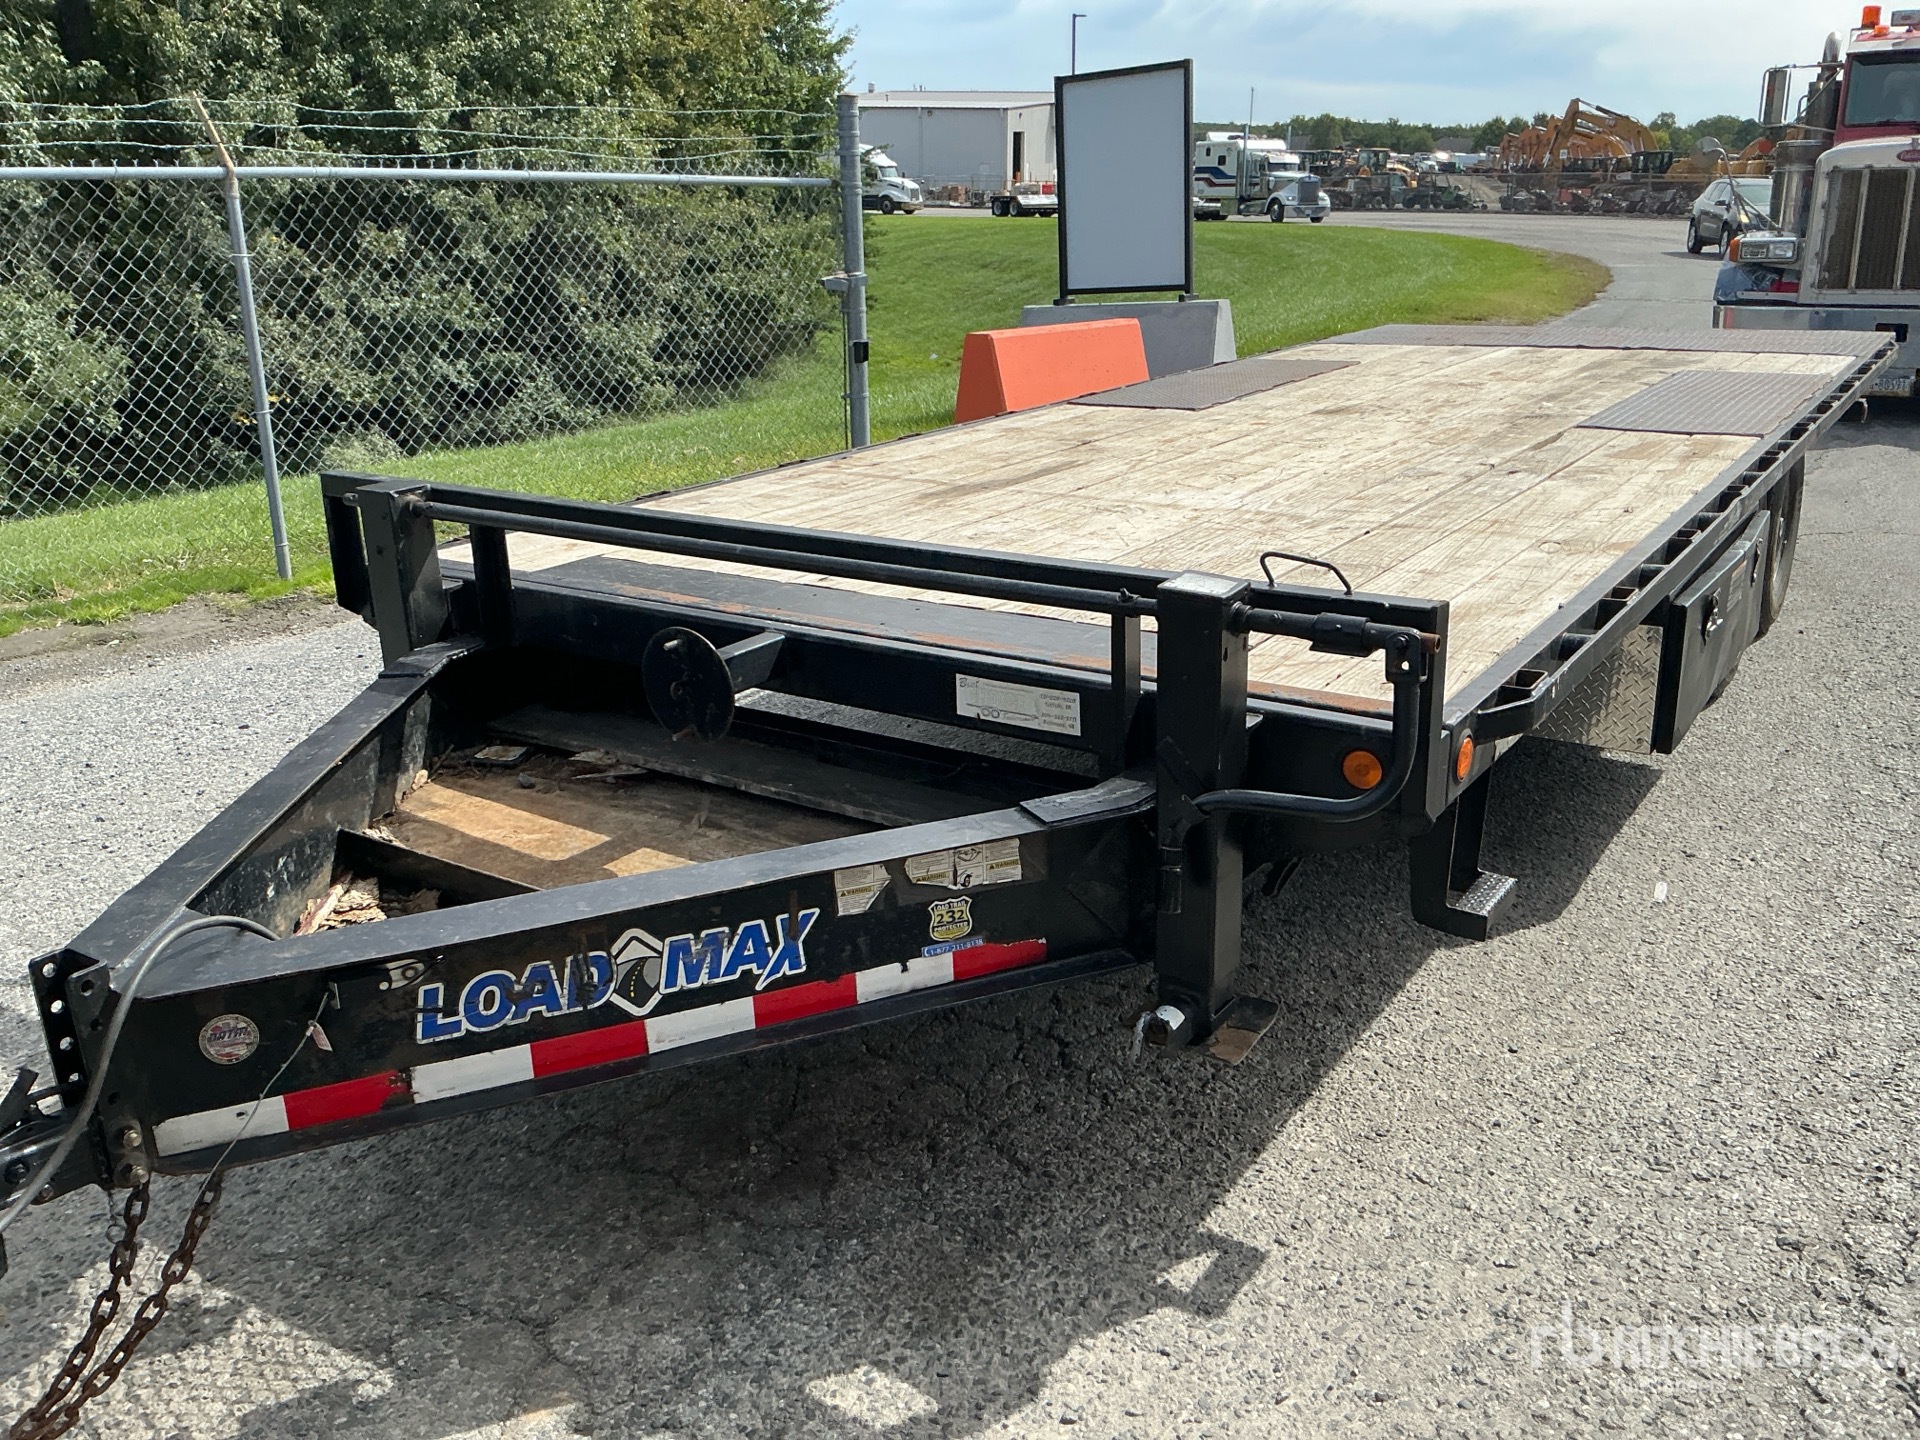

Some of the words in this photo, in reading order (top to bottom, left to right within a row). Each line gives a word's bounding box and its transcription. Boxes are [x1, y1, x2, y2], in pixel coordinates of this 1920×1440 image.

[934, 904, 950, 912] LOAD
[950, 901, 967, 909] TRAIL
[936, 910, 965, 925] 232
[934, 922, 968, 931] PROTECTED
[416, 951, 618, 1045] LOAD
[659, 907, 820, 995] MAX
